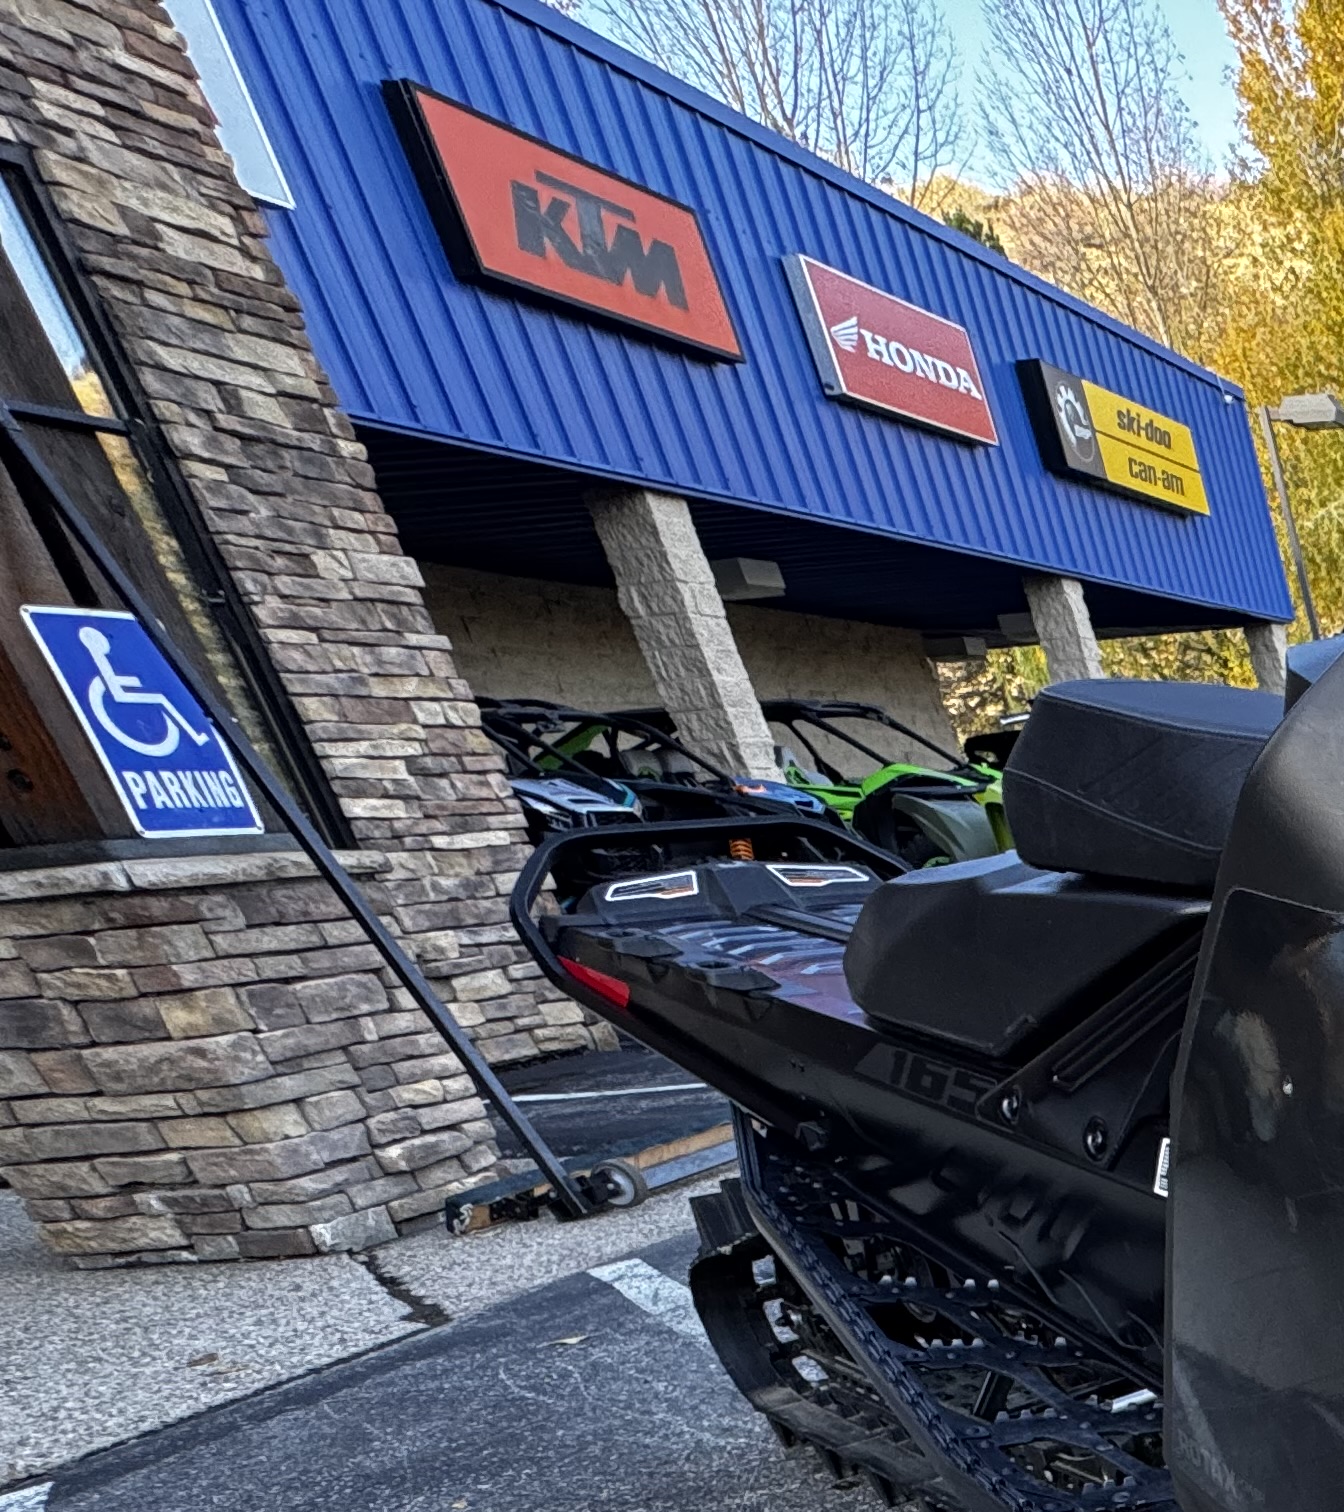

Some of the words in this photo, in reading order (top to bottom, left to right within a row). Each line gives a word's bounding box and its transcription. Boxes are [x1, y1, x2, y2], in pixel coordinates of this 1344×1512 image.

[510, 169, 689, 312] KTM
[860, 328, 983, 400] HONDA
[1116, 408, 1172, 450] ski-doo
[1128, 457, 1185, 496] can-am
[122, 770, 244, 809] PARKING
